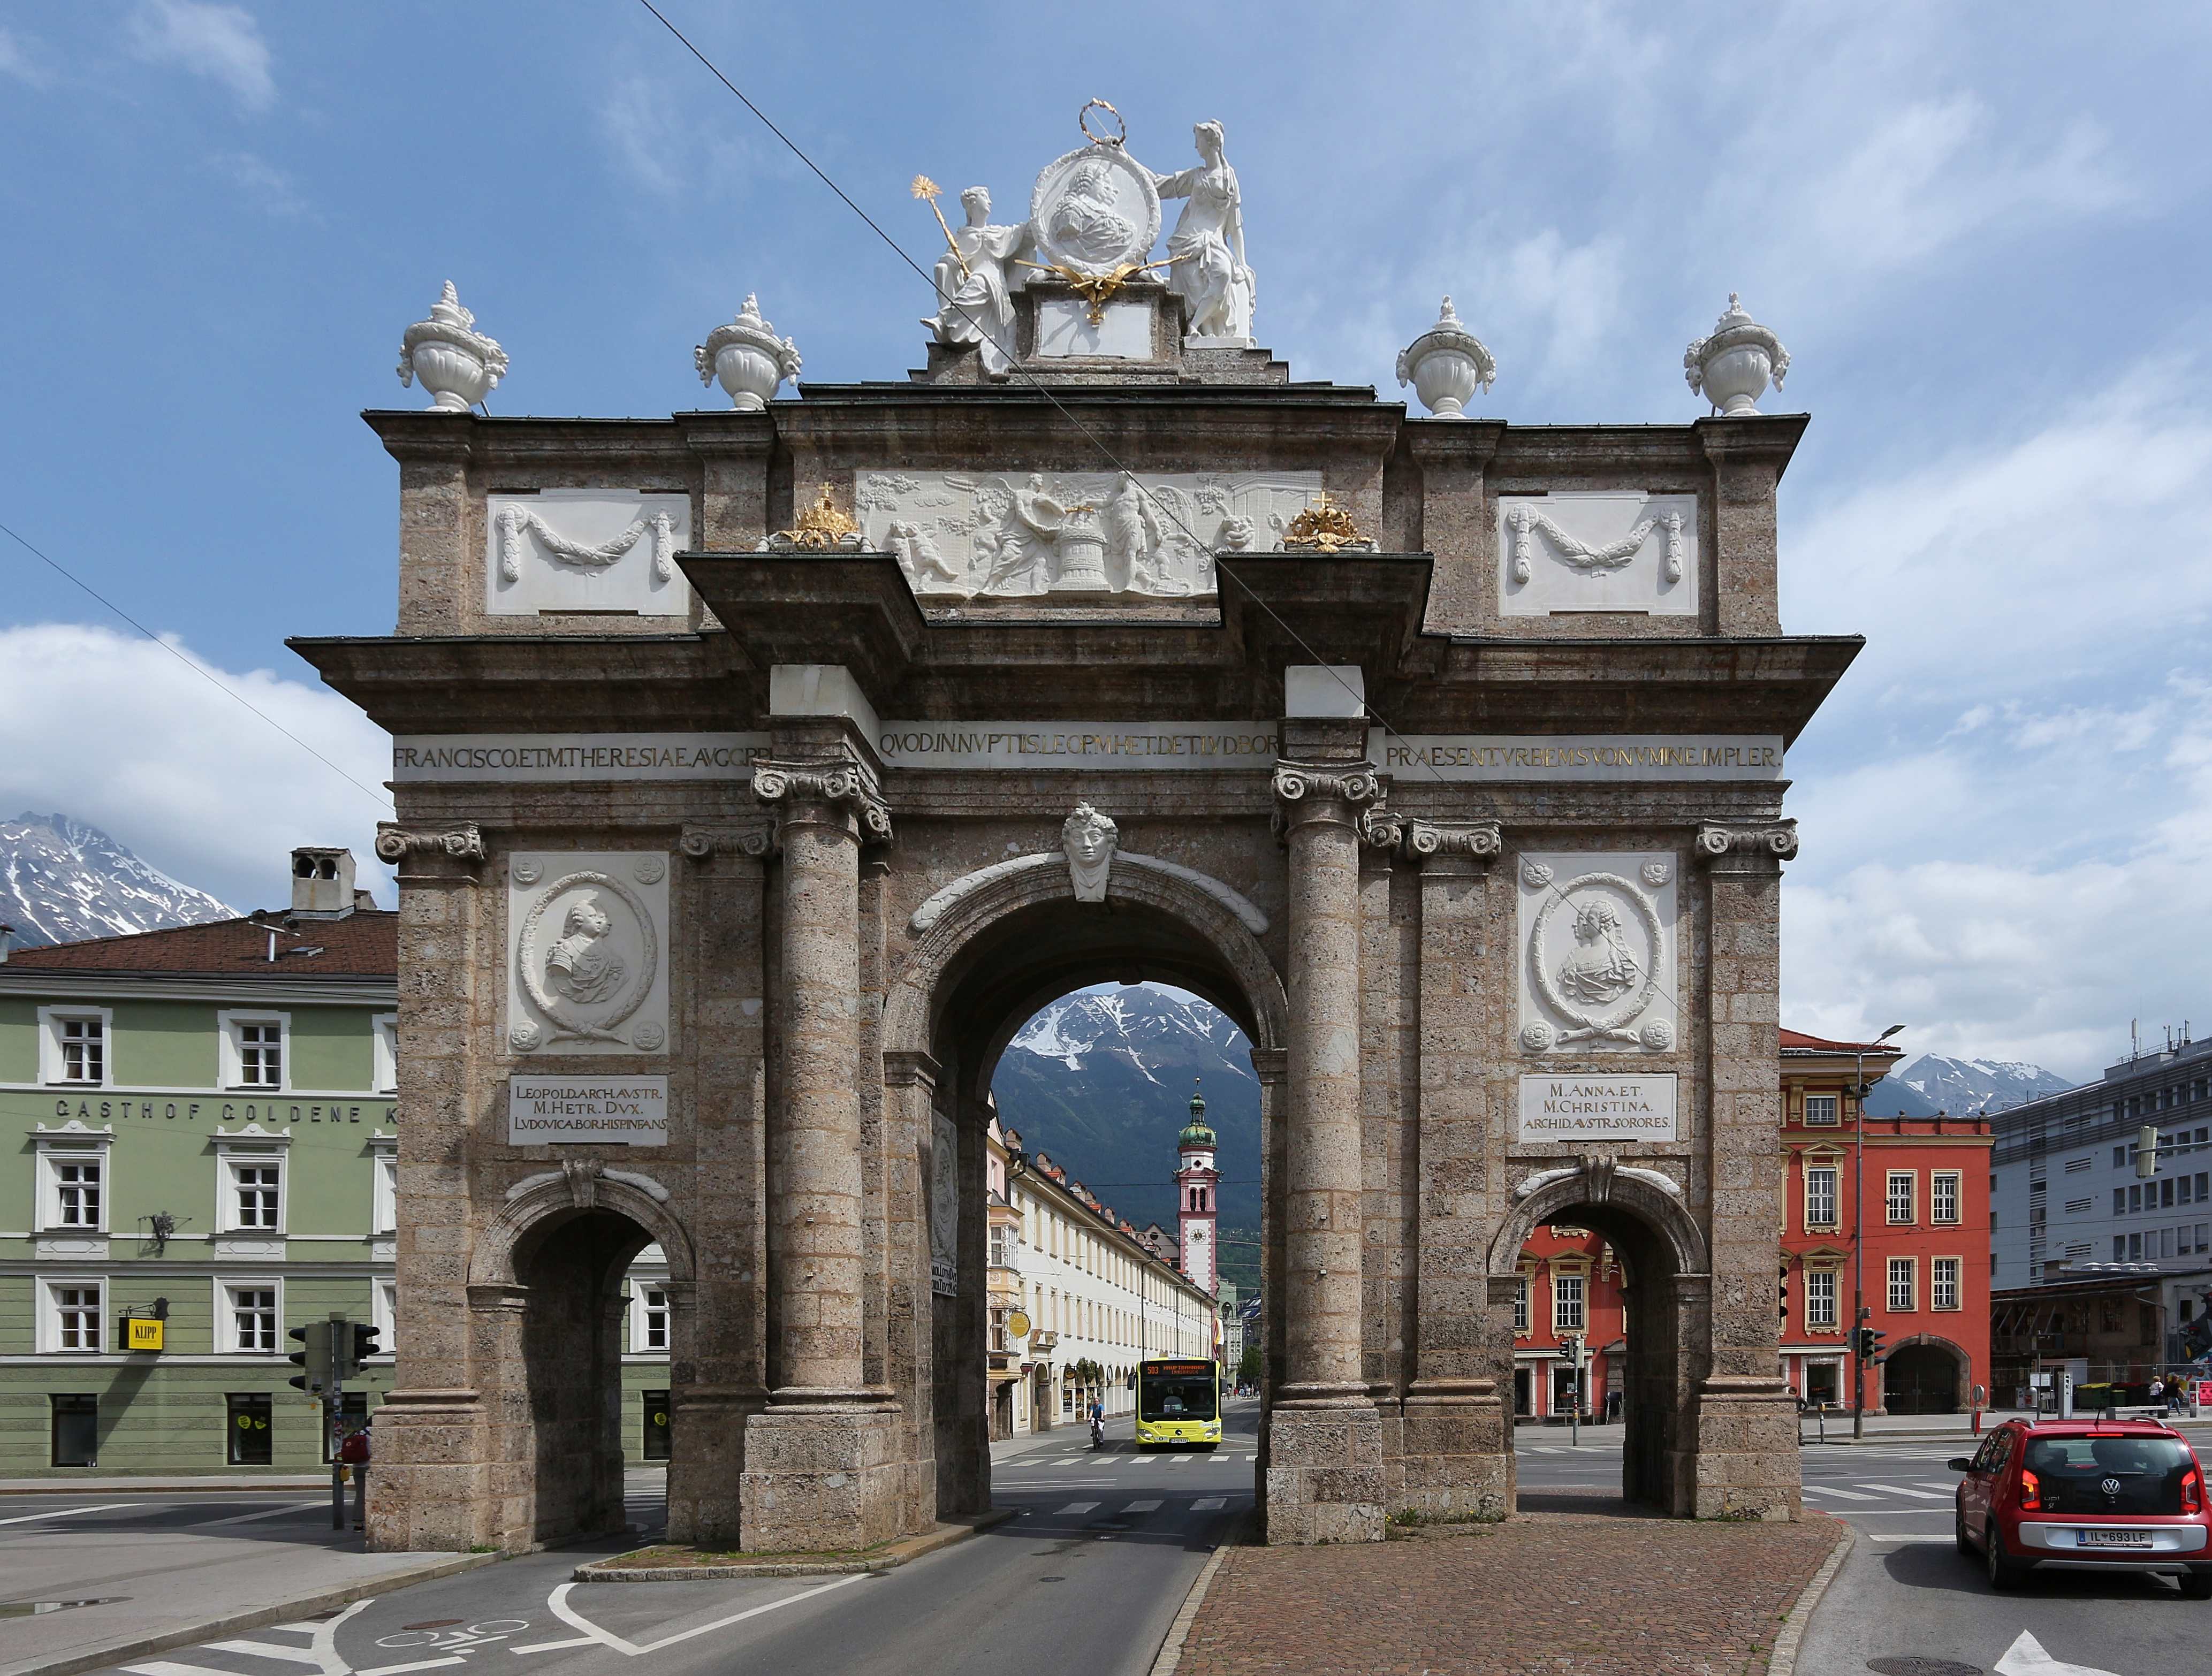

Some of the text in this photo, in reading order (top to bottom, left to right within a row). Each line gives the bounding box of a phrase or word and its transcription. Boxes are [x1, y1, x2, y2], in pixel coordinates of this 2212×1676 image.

[56, 1100, 200, 1119] GASTHOF
[222, 1104, 360, 1123] GOLDENE
[135, 1325, 157, 1339] KLIPP
[2091, 1532, 2146, 1542] IL 693 LF
